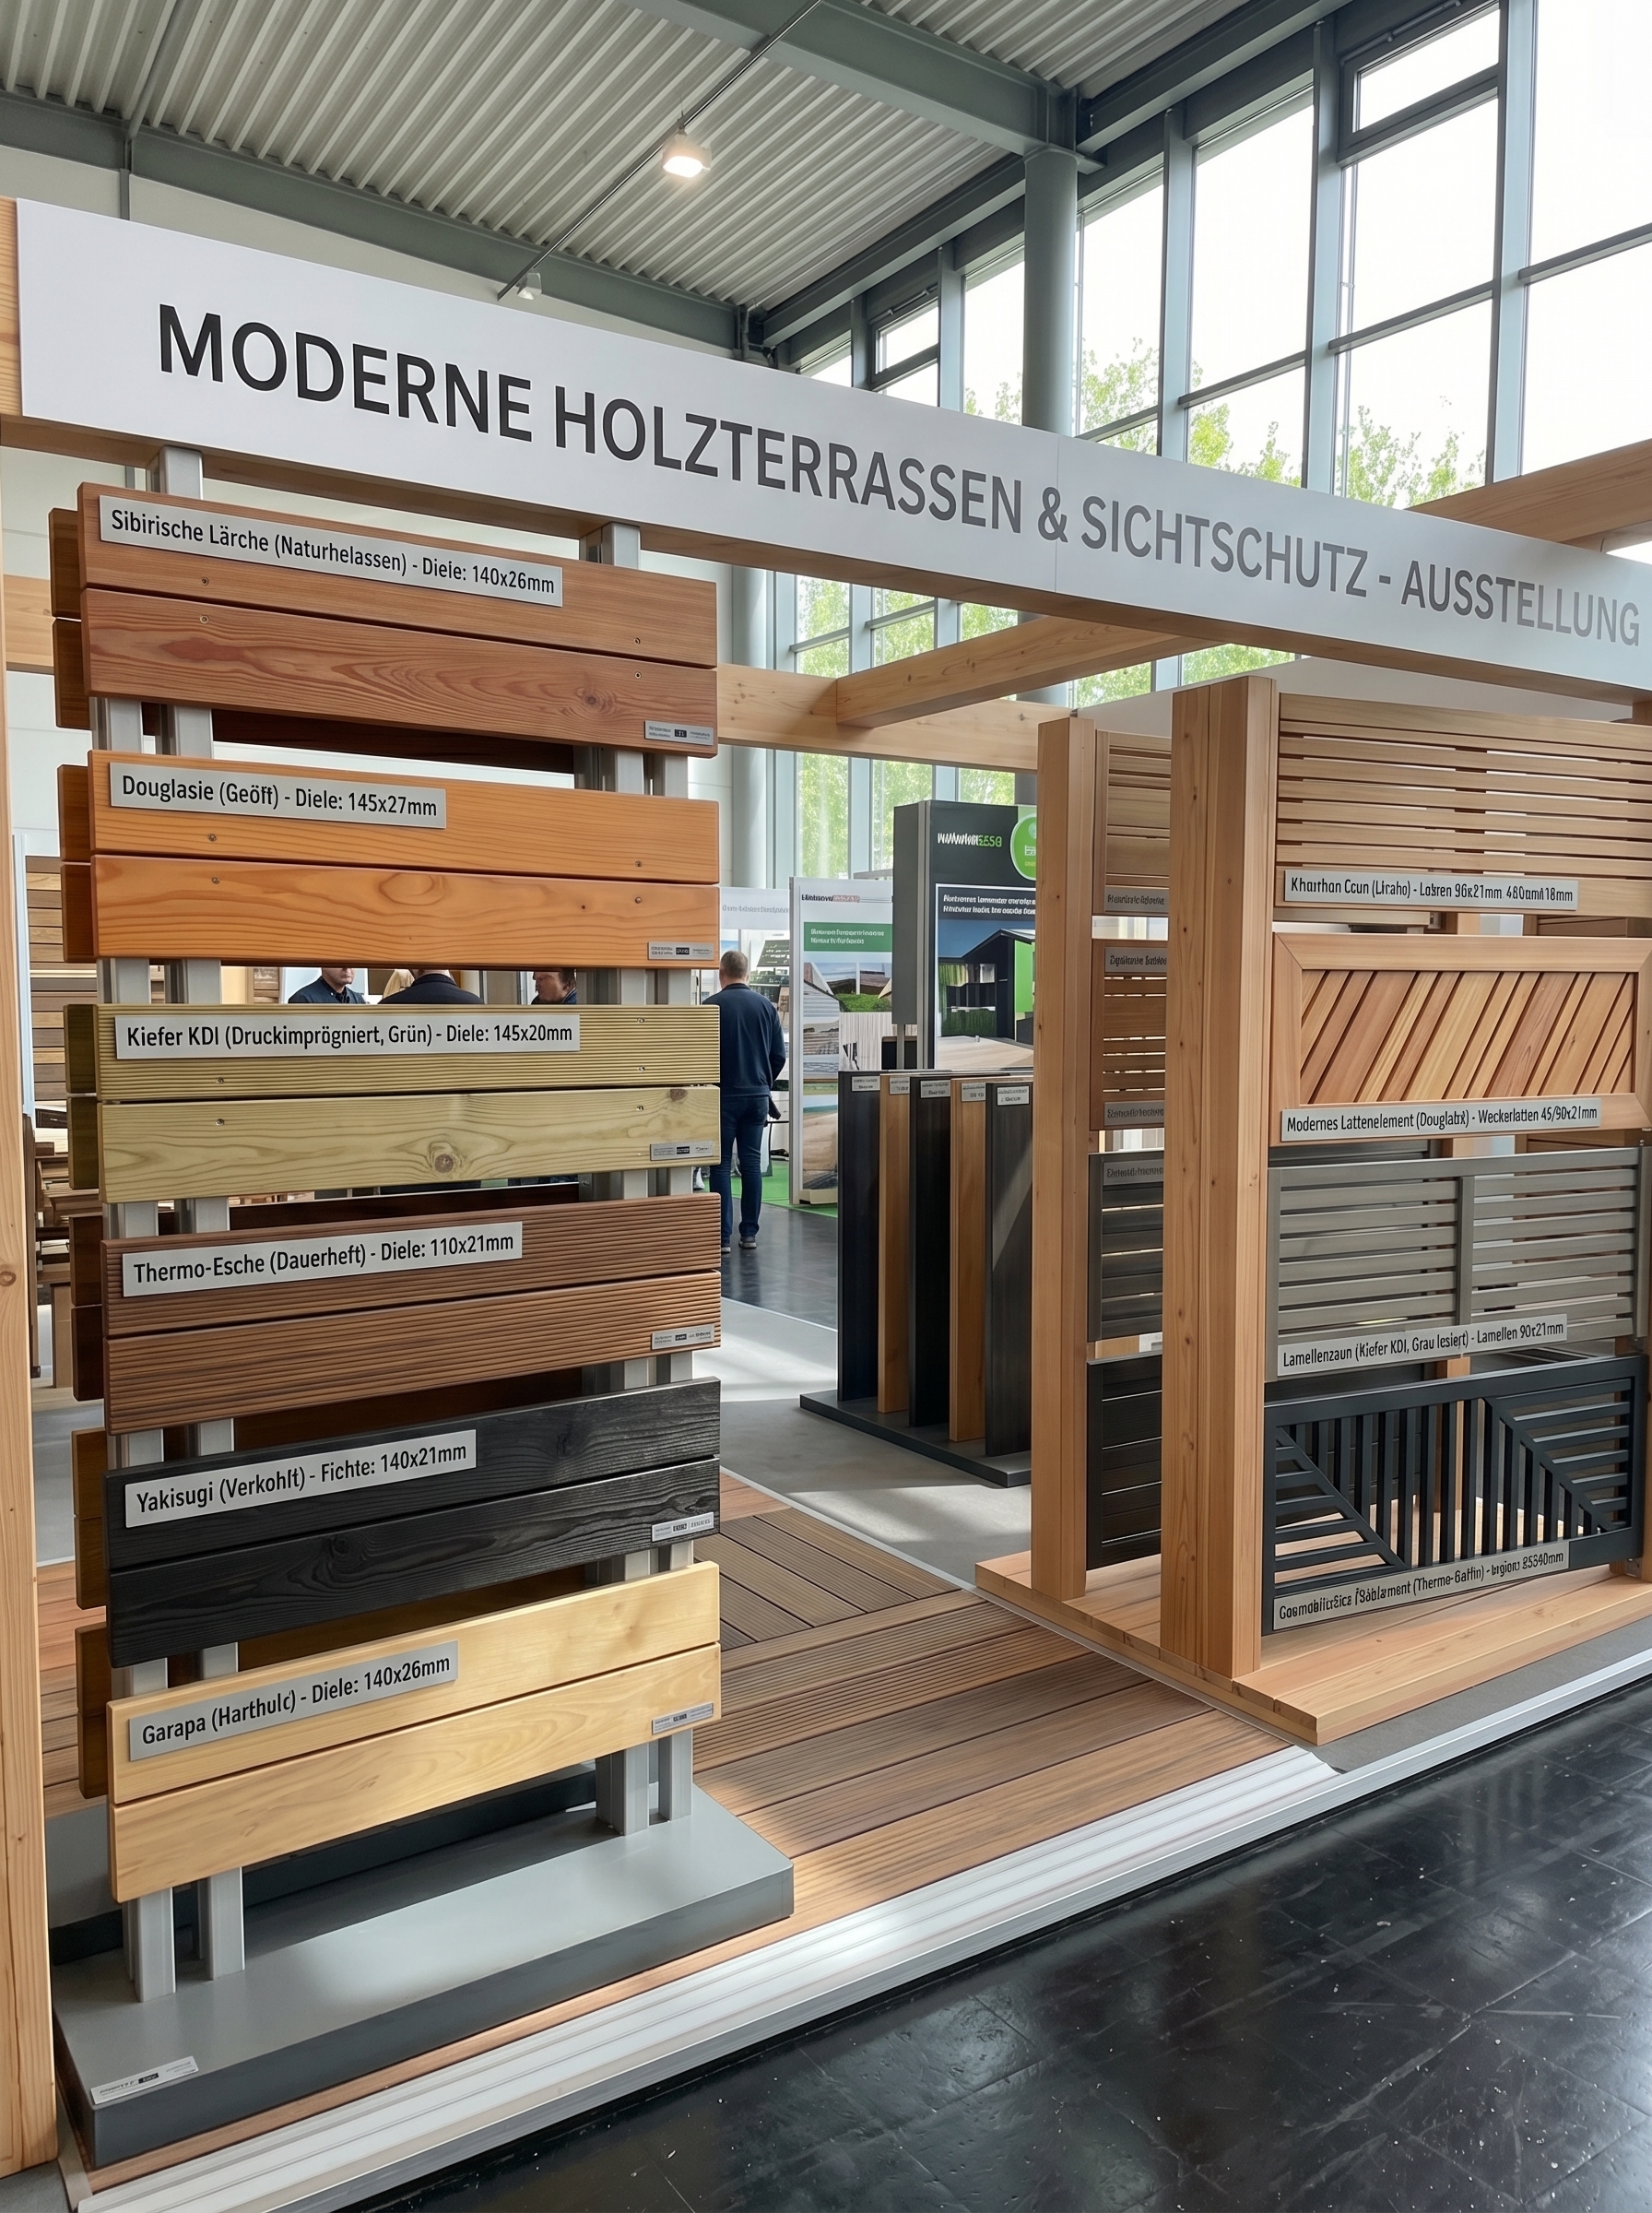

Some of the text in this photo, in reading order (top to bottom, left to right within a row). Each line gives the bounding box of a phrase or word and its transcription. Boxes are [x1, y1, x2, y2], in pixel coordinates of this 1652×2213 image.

[159, 303, 532, 443] MODERNE
[556, 385, 1021, 533] HOLZTERRASSEN
[1037, 486, 1068, 543] &
[1080, 495, 1367, 598] SICHTSCHUTZ
[1401, 560, 1640, 647] AUSSTELLUNG
[112, 509, 204, 541] Sibirische
[209, 525, 269, 551] Lärche
[275, 534, 407, 576] (Naturhelassen)
[472, 565, 555, 594] 140x26mm
[123, 775, 214, 802] Douglasie
[296, 787, 343, 810] Diele:
[348, 792, 437, 816] 145x27mm
[127, 1025, 183, 1046] Kiefer
[188, 1026, 218, 1046] KDI
[388, 1024, 432, 1047] Grün)
[447, 1024, 490, 1042] Diele:
[494, 1024, 572, 1042] 145x20mm
[1287, 1116, 1338, 1132] Modernes
[1341, 1113, 1414, 1130] Lattenelement
[1479, 1108, 1539, 1124] Weckerlatten
[134, 1253, 265, 1283] Thermo-Esche
[270, 1243, 366, 1275] (Dauerheft)
[381, 1239, 426, 1260] Diele:
[431, 1235, 513, 1256] 110x21mm
[1283, 1348, 1352, 1367] Lamellenzaun
[1355, 1342, 1387, 1363] (Kiefer
[1412, 1337, 1434, 1352] Grau
[1477, 1326, 1517, 1343] Lamellen
[136, 1482, 213, 1513] Yakisugi
[321, 1460, 374, 1482] Fichte:
[381, 1444, 466, 1472] 140x21mm
[142, 1717, 206, 1745] Garapa
[312, 1680, 359, 1703] Diele:
[364, 1657, 450, 1690] 140x26mm
